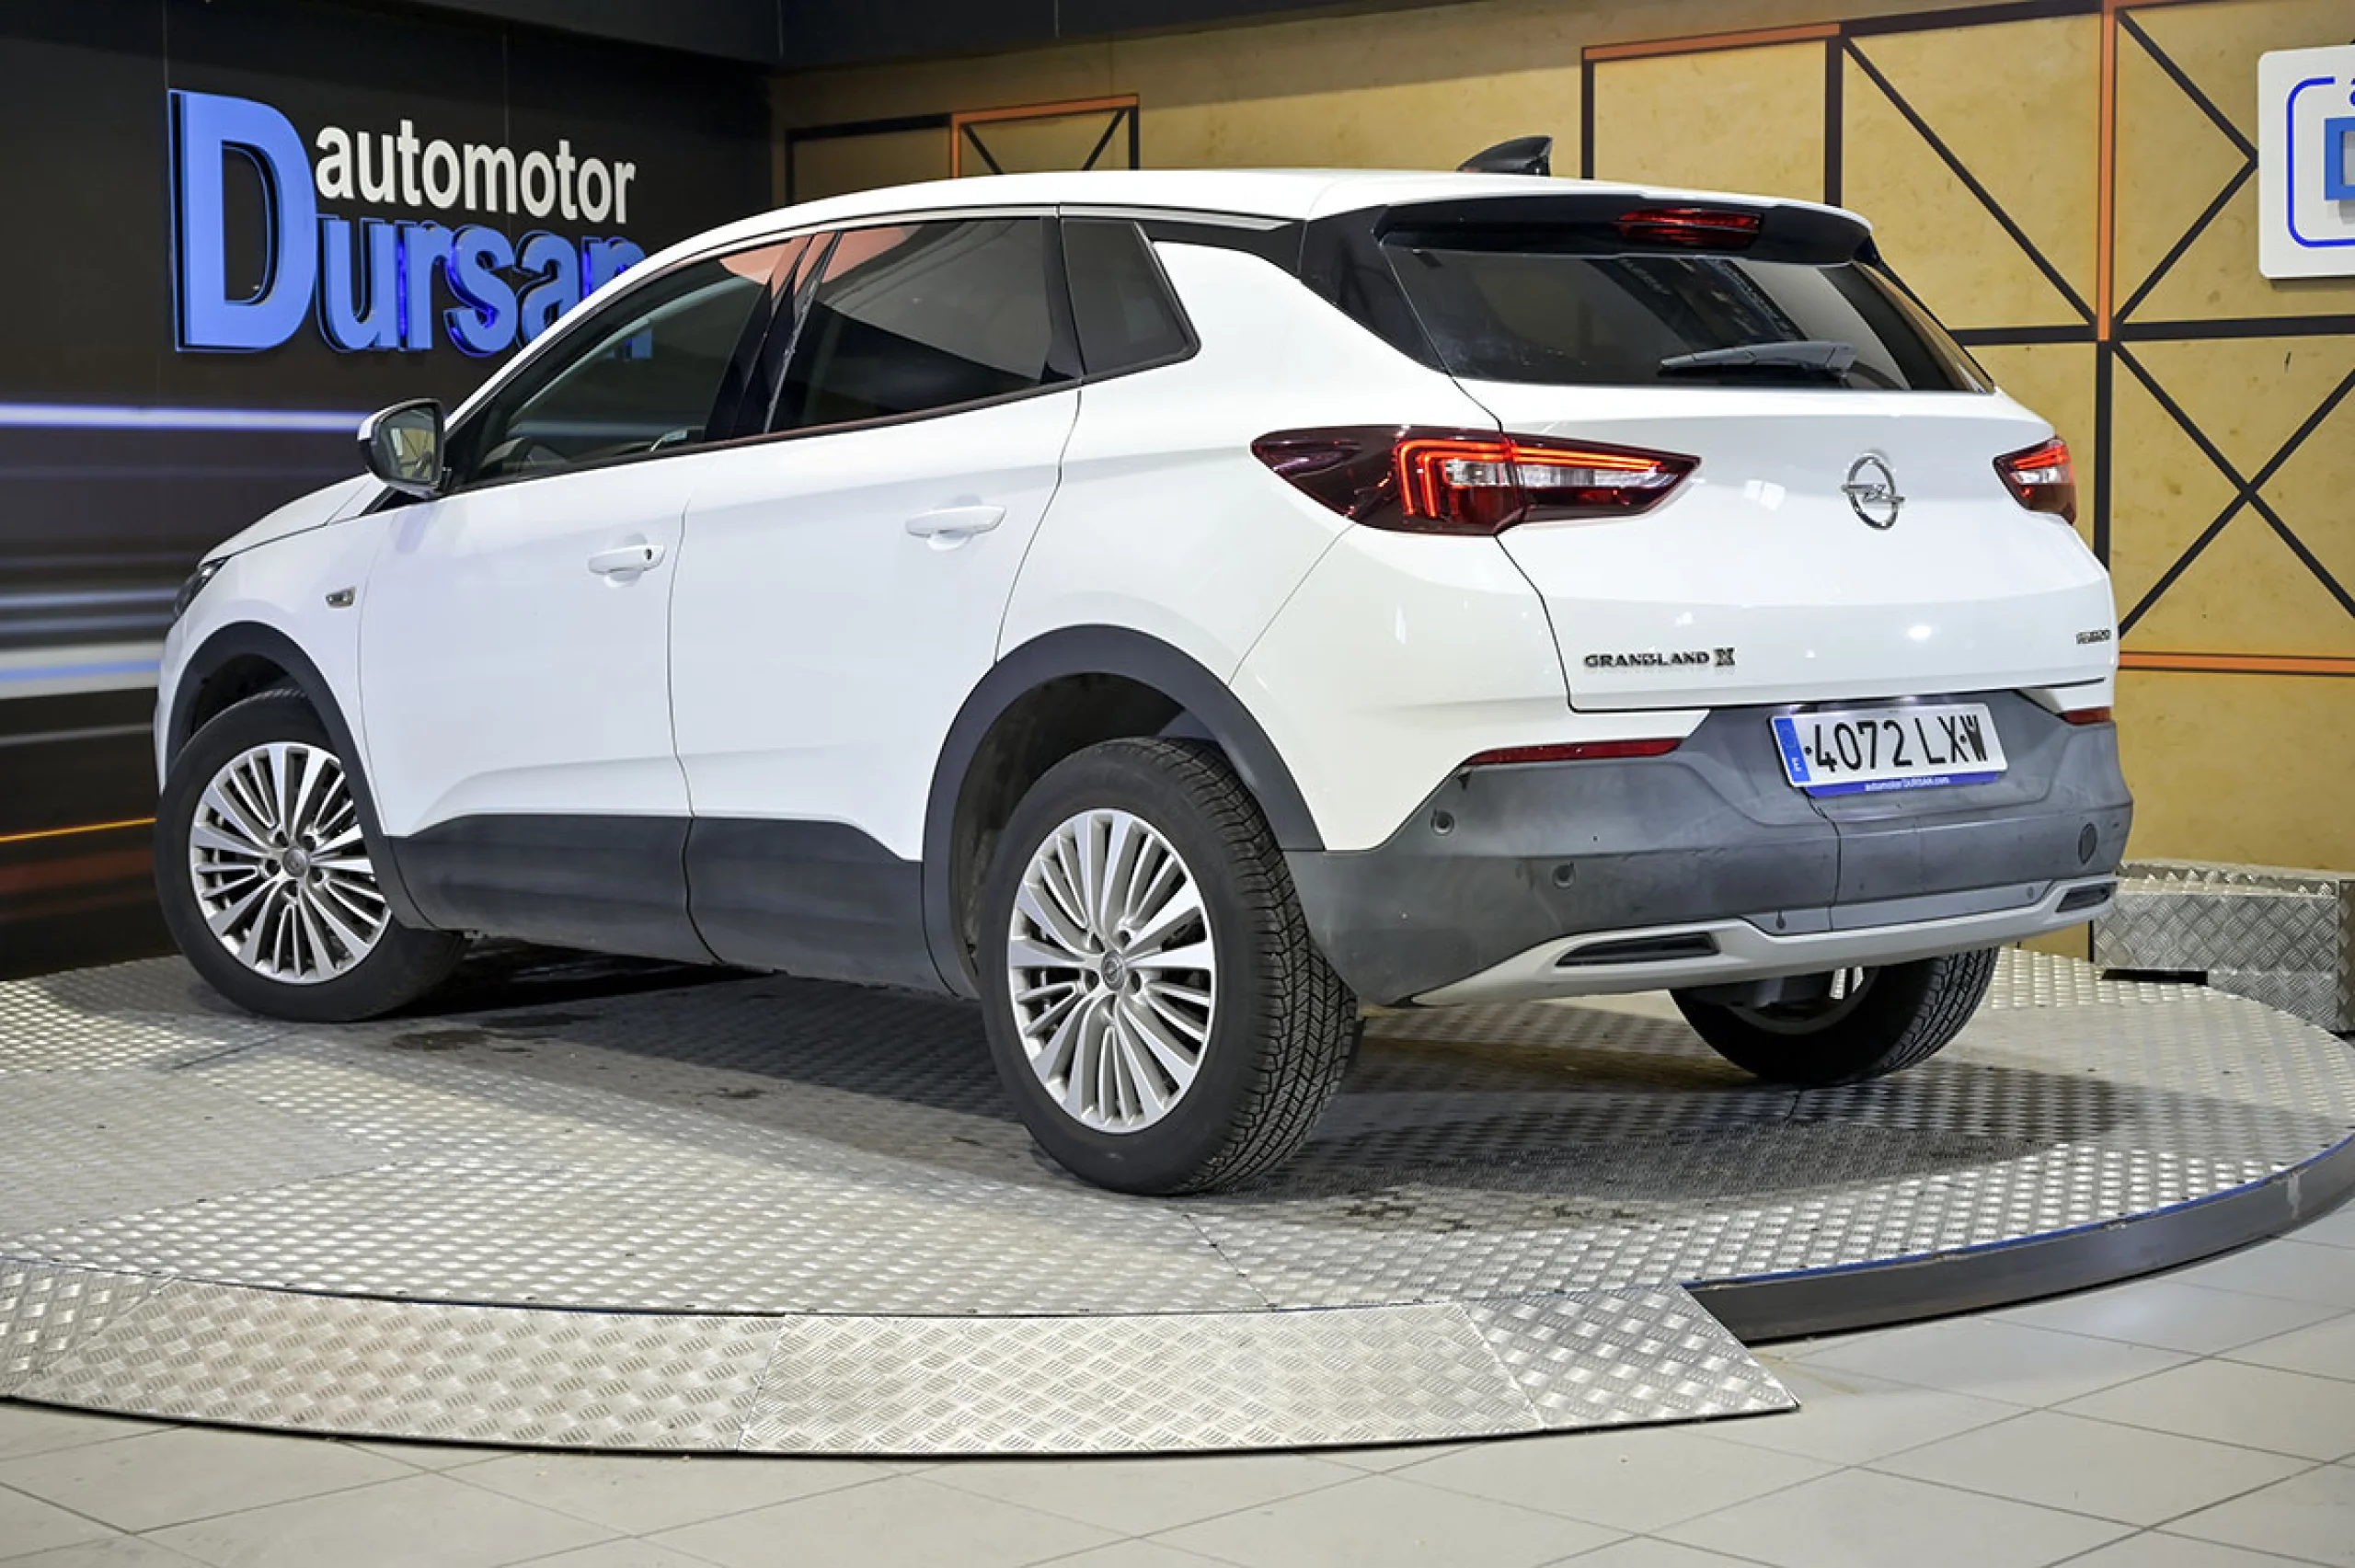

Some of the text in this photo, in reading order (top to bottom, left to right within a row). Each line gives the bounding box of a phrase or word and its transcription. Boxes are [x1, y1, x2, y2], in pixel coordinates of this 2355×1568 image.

[315, 119, 637, 223] automotor
[1584, 647, 1736, 668] GRANDLAND X
[1814, 714, 1989, 773] 4072 LXW
